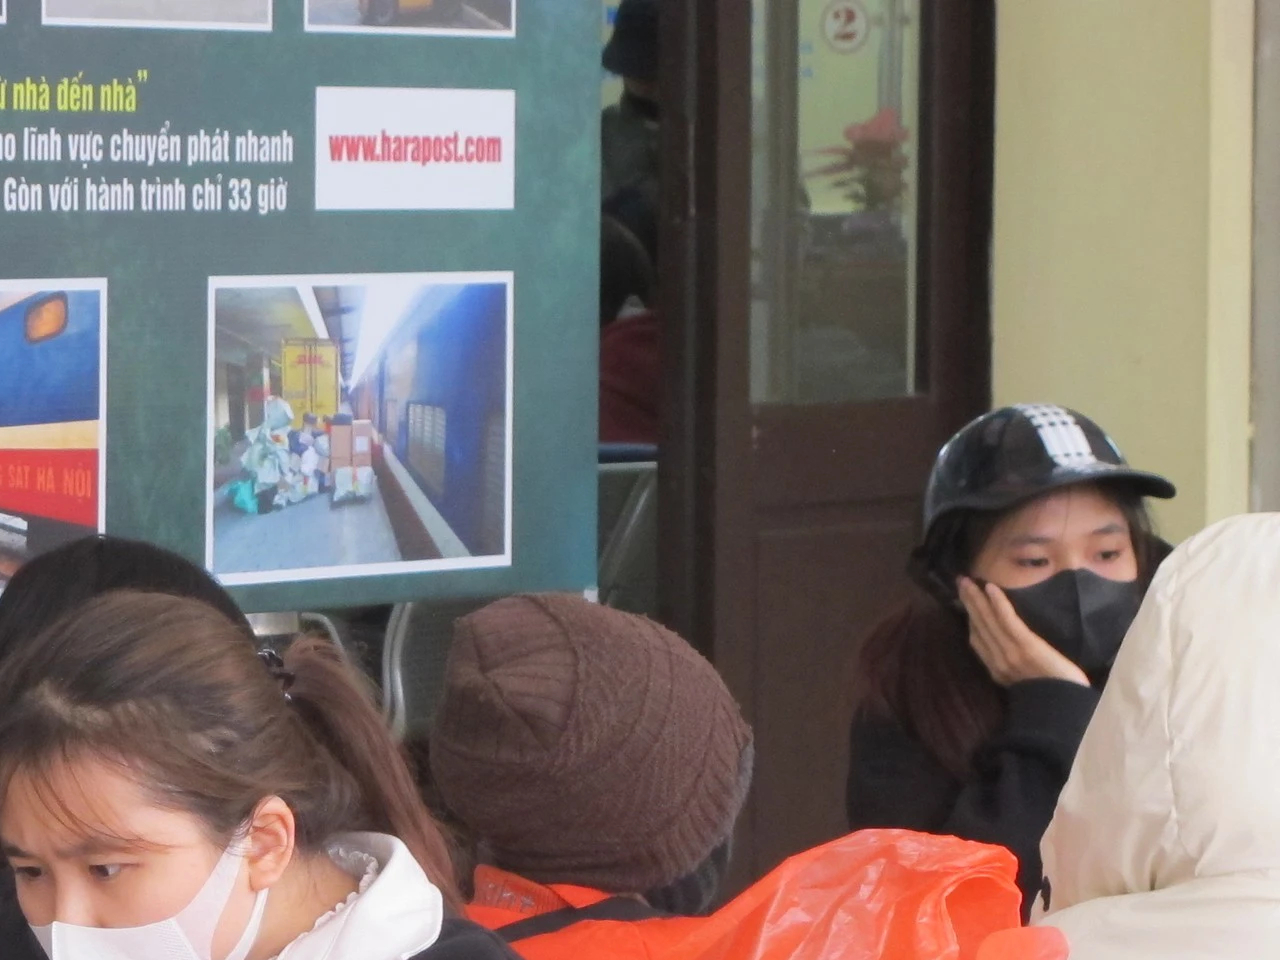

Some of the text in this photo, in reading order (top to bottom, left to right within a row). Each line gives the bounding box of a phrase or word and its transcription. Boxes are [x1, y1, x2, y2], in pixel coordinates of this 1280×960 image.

[832, 7, 857, 41] 2
[12, 76, 50, 112] nhà
[56, 71, 93, 112] đến
[23, 127, 62, 161] lĩnh
[68, 130, 103, 169] vực
[110, 120, 181, 166] chuyển
[187, 128, 230, 166] phát
[235, 129, 294, 163] nhanh
[328, 129, 502, 166] www.harapost.com
[3, 176, 42, 212] Gòn
[48, 176, 79, 211] với
[86, 176, 135, 211] hành
[140, 176, 186, 211] trình
[192, 173, 223, 211] chỉ
[228, 178, 252, 211] 33
[258, 176, 288, 215] giờ
